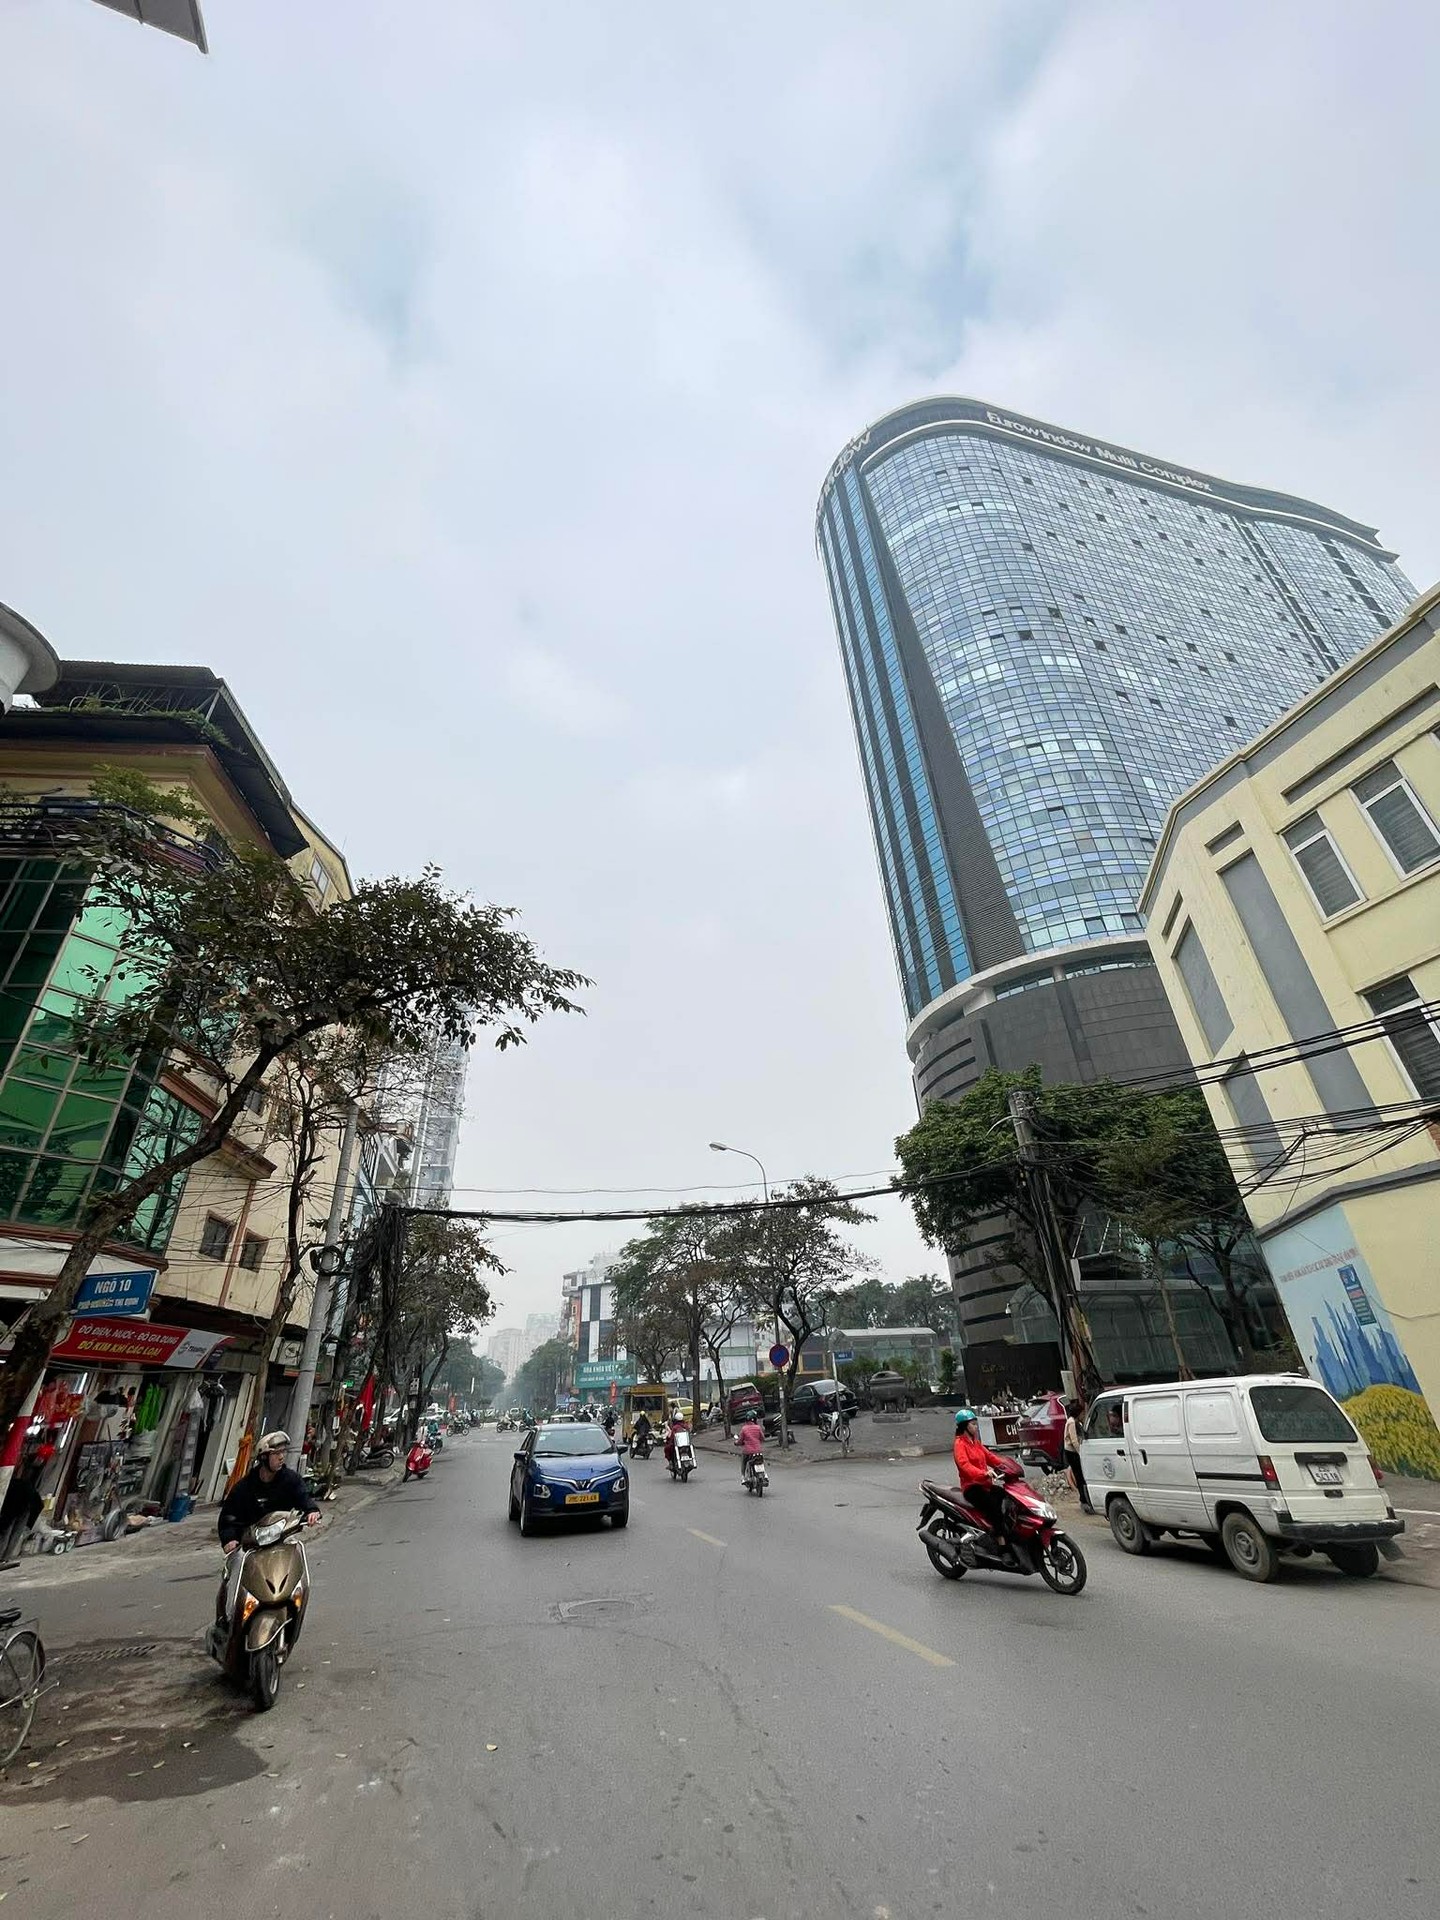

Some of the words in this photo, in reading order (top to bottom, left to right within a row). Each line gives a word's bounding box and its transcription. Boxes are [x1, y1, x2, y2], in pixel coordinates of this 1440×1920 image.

[986, 410, 1091, 454] Eurowindow
[1095, 446, 1138, 469] Multi
[1140, 460, 1213, 492] Complex
[119, 1279, 132, 1292] 10
[92, 1341, 112, 1351] KIM
